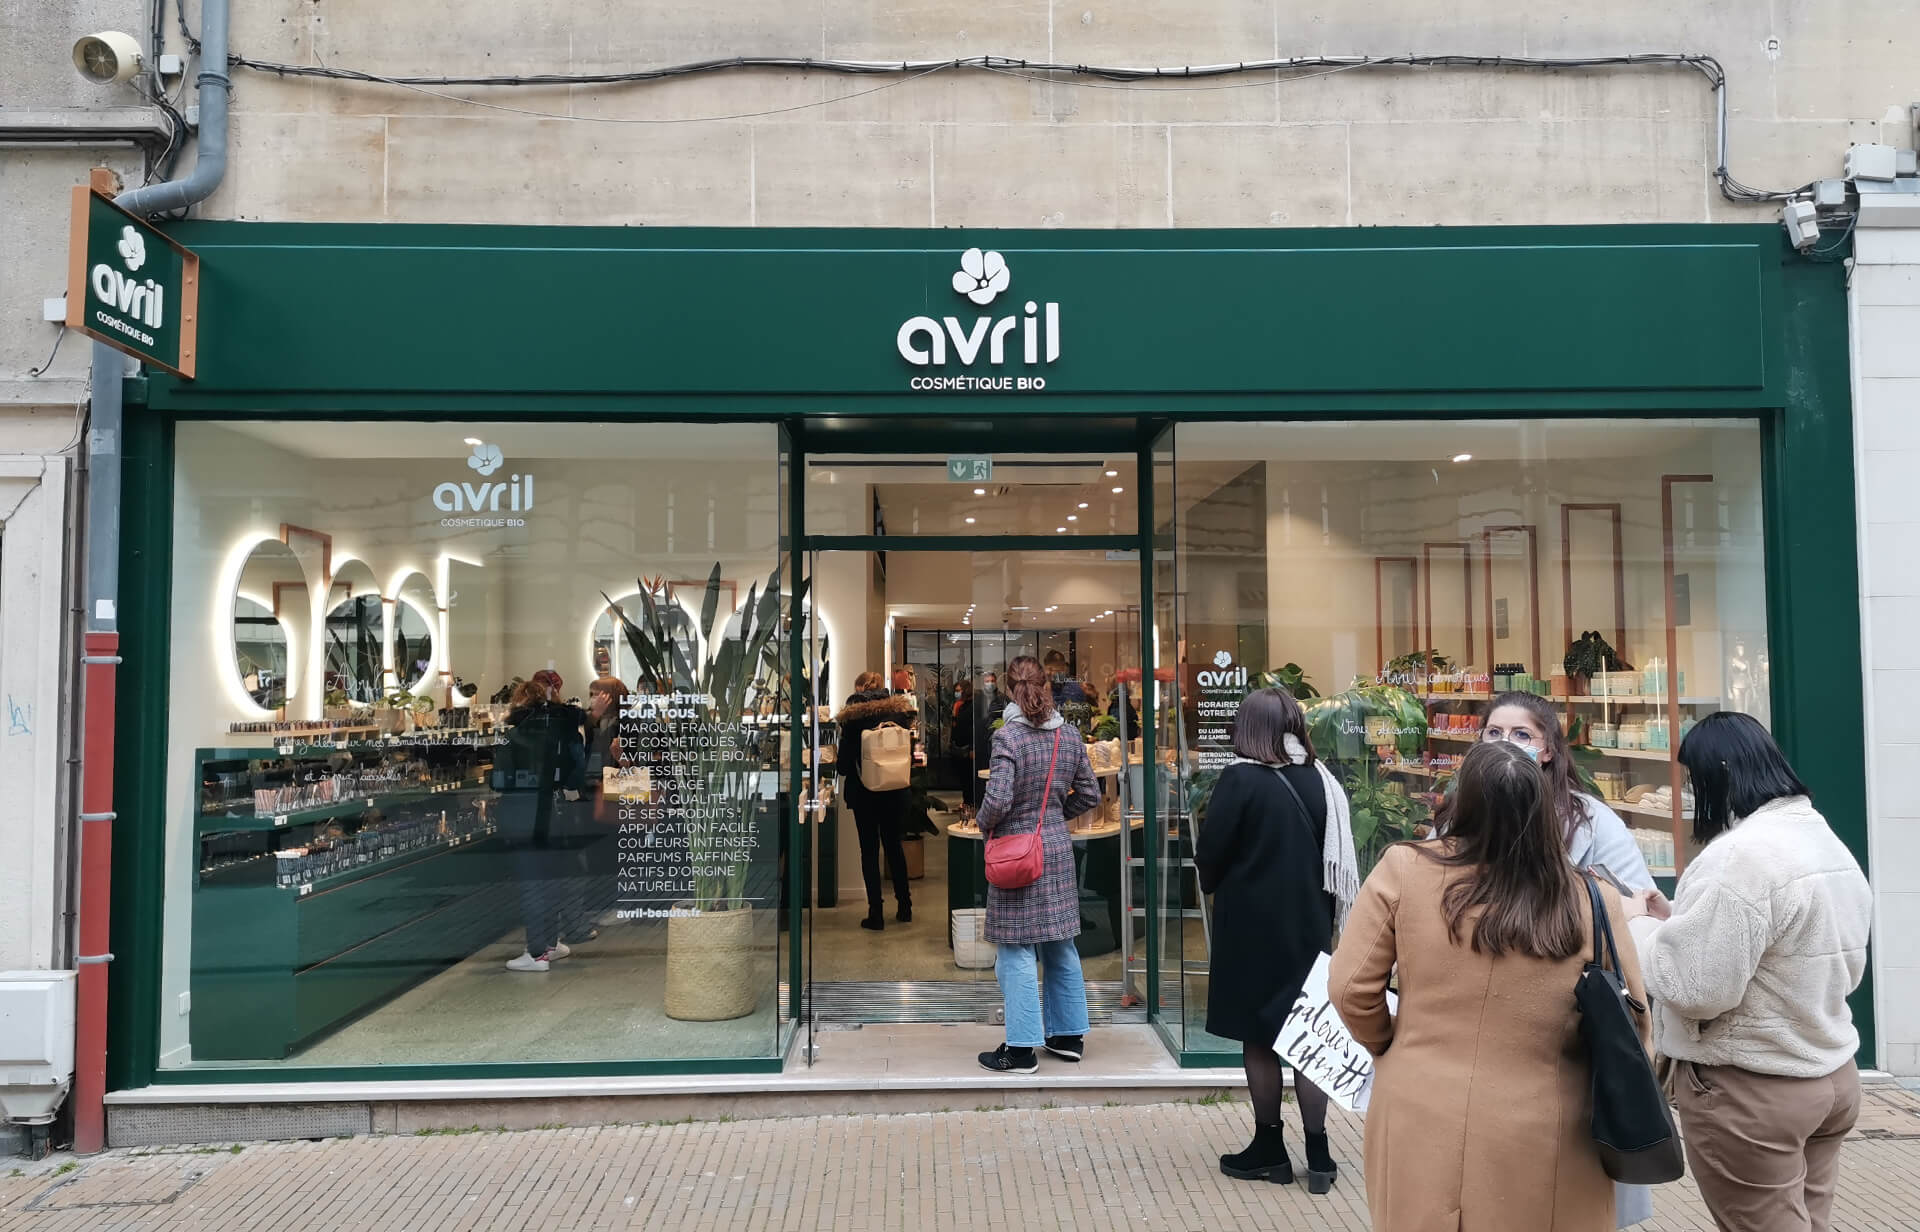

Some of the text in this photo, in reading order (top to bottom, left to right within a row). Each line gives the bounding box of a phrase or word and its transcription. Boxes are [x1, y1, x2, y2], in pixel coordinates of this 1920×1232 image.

[92, 264, 164, 328] avril
[97, 311, 154, 346] COSMÉTIQUE BIO
[897, 301, 1060, 365] avril
[911, 375, 1045, 390] COSMÉTIQUE BIO
[433, 474, 533, 511] avril
[507, 519, 524, 527] BIO
[1197, 667, 1247, 687] avril
[619, 694, 634, 705] LE
[1197, 701, 1240, 709] HORAIRES
[619, 708, 699, 719] POUR TOUS.
[1198, 709, 1225, 717] VOTRE
[619, 722, 755, 735] MARQUE FRANÇAISE
[619, 735, 737, 748] DE COSMÉTIQUES,
[619, 751, 658, 762] AVRIL
[662, 751, 697, 761] REND
[703, 751, 718, 761] LE
[619, 766, 699, 776] ACCESSIBLE
[619, 792, 727, 805] SUR LA QUALITÉ
[619, 809, 636, 820] DE
[641, 809, 664, 819] SES
[668, 808, 734, 819] PRODUITS
[618, 822, 759, 834] APPLICATION FACILE,
[618, 837, 760, 848] COULEURS INTENSES,
[618, 849, 752, 863] PARFUMS RAFFINÉS,
[618, 866, 735, 877] ACTIFS D'ORIGINE
